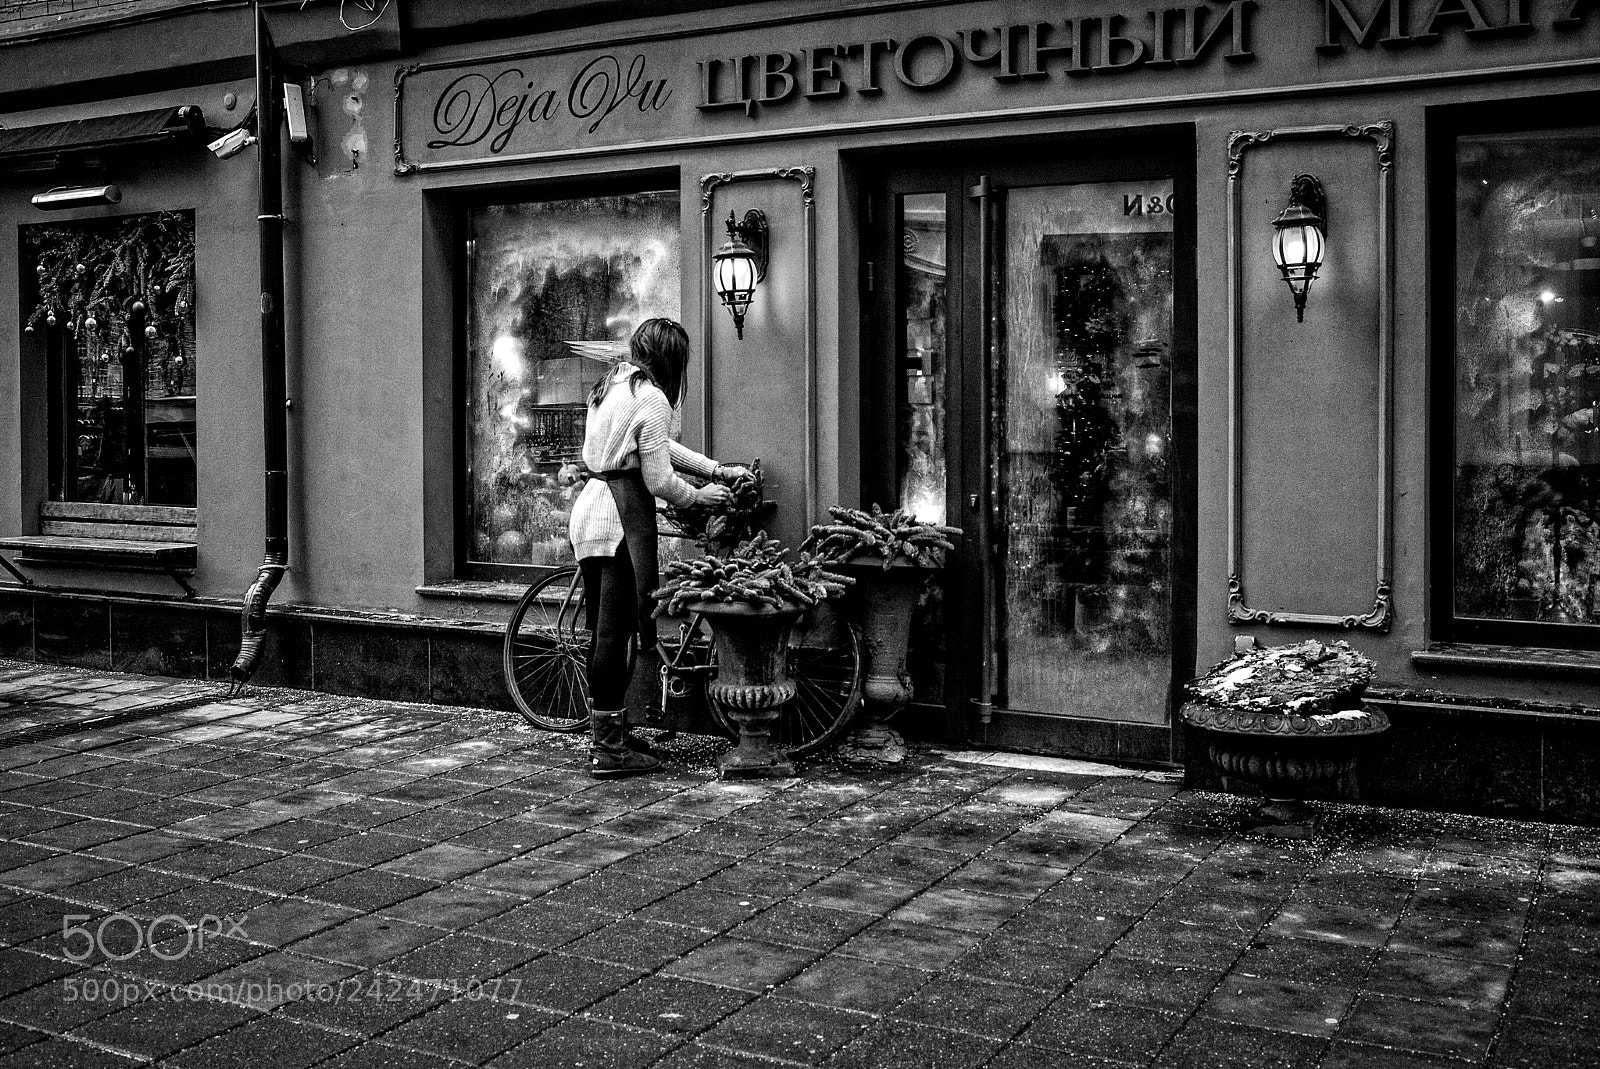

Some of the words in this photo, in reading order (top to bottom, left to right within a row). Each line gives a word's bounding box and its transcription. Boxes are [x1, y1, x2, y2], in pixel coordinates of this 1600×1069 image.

[427, 68, 562, 154] Deja
[567, 53, 674, 134] Vu
[695, 0, 1253, 117] ЦВЕТОЧНЫЙ
[1316, 0, 1600, 51] МА
